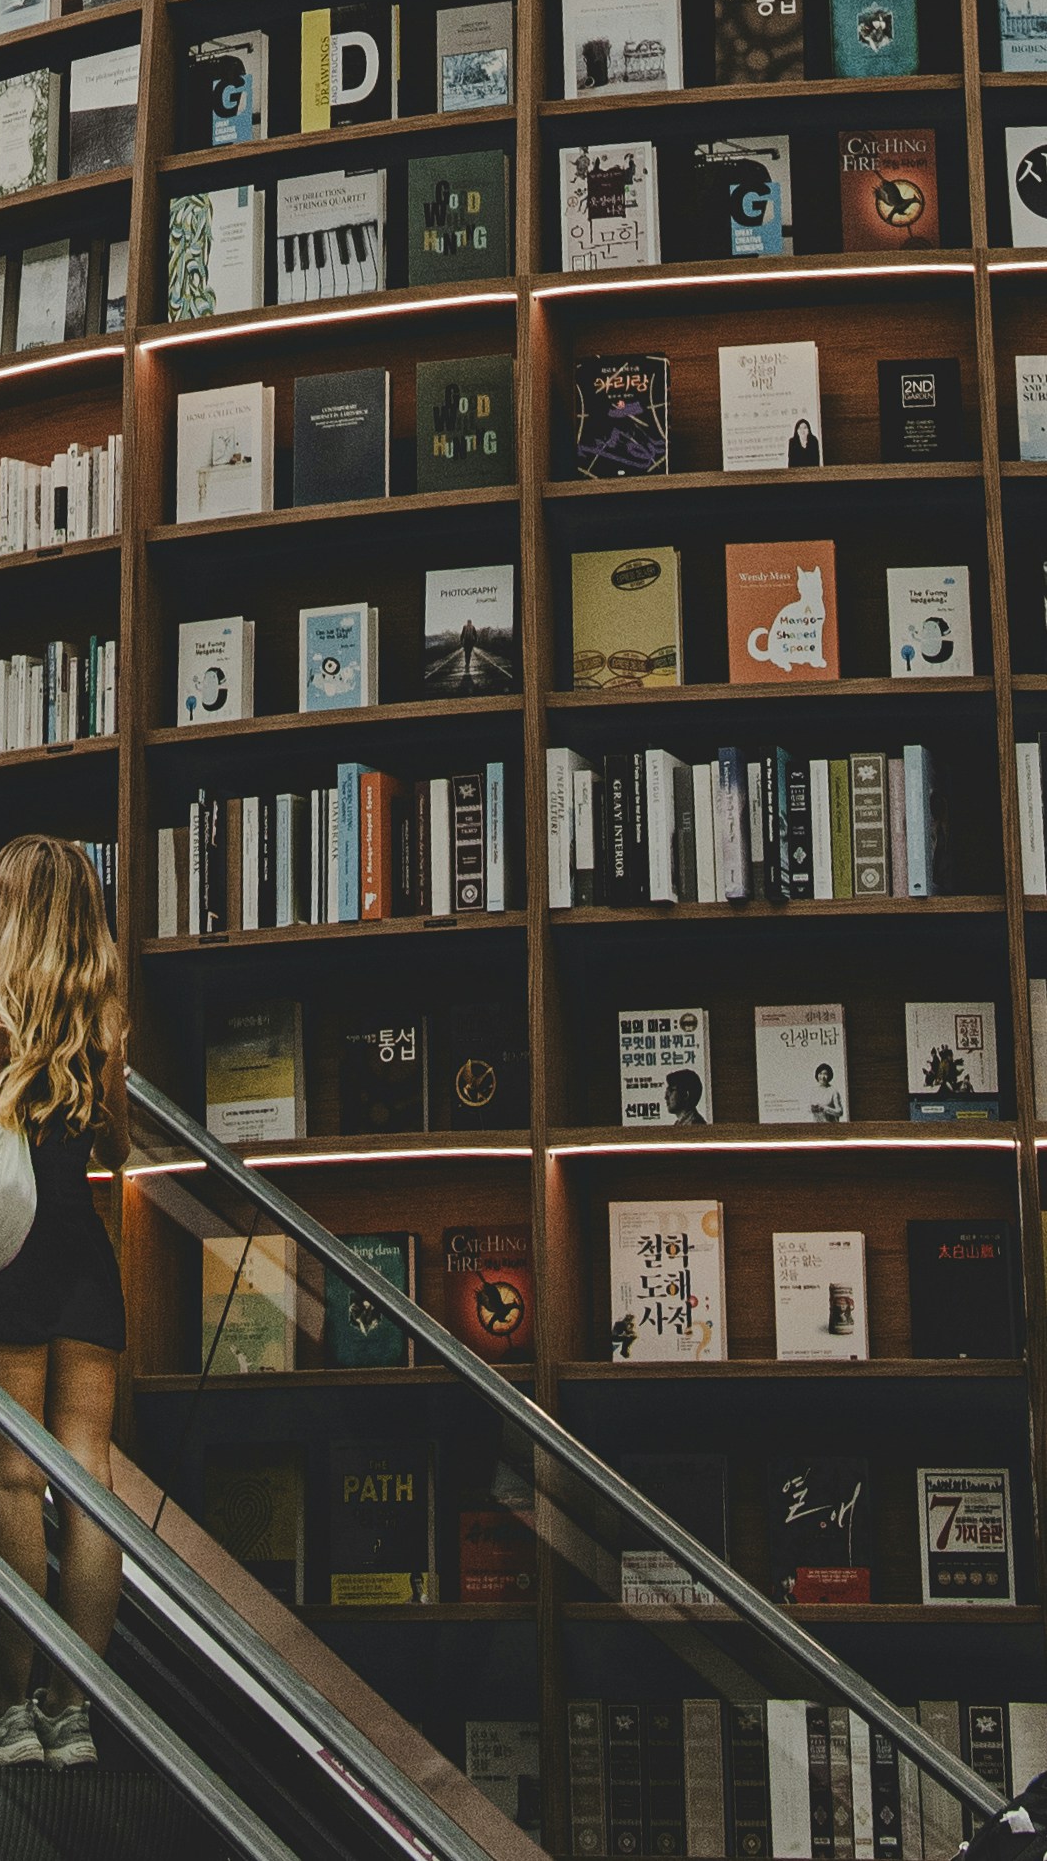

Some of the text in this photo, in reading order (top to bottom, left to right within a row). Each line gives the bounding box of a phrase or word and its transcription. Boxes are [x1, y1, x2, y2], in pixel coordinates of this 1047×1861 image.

[320, 36, 330, 106] DRAWINGS
[331, 31, 379, 106] D
[904, 380, 934, 394] 2ND
[739, 571, 768, 583] Wendy
[440, 586, 498, 598] PHOTOGRAPHY
[780, 615, 823, 626] Mango-
[776, 629, 816, 639] Shaped
[782, 643, 815, 654] Space
[614, 825, 624, 877] INTERIOR
[625, 1103, 660, 1118] 선대인
[343, 1474, 414, 1503] PATH
[929, 1494, 962, 1551] 7
